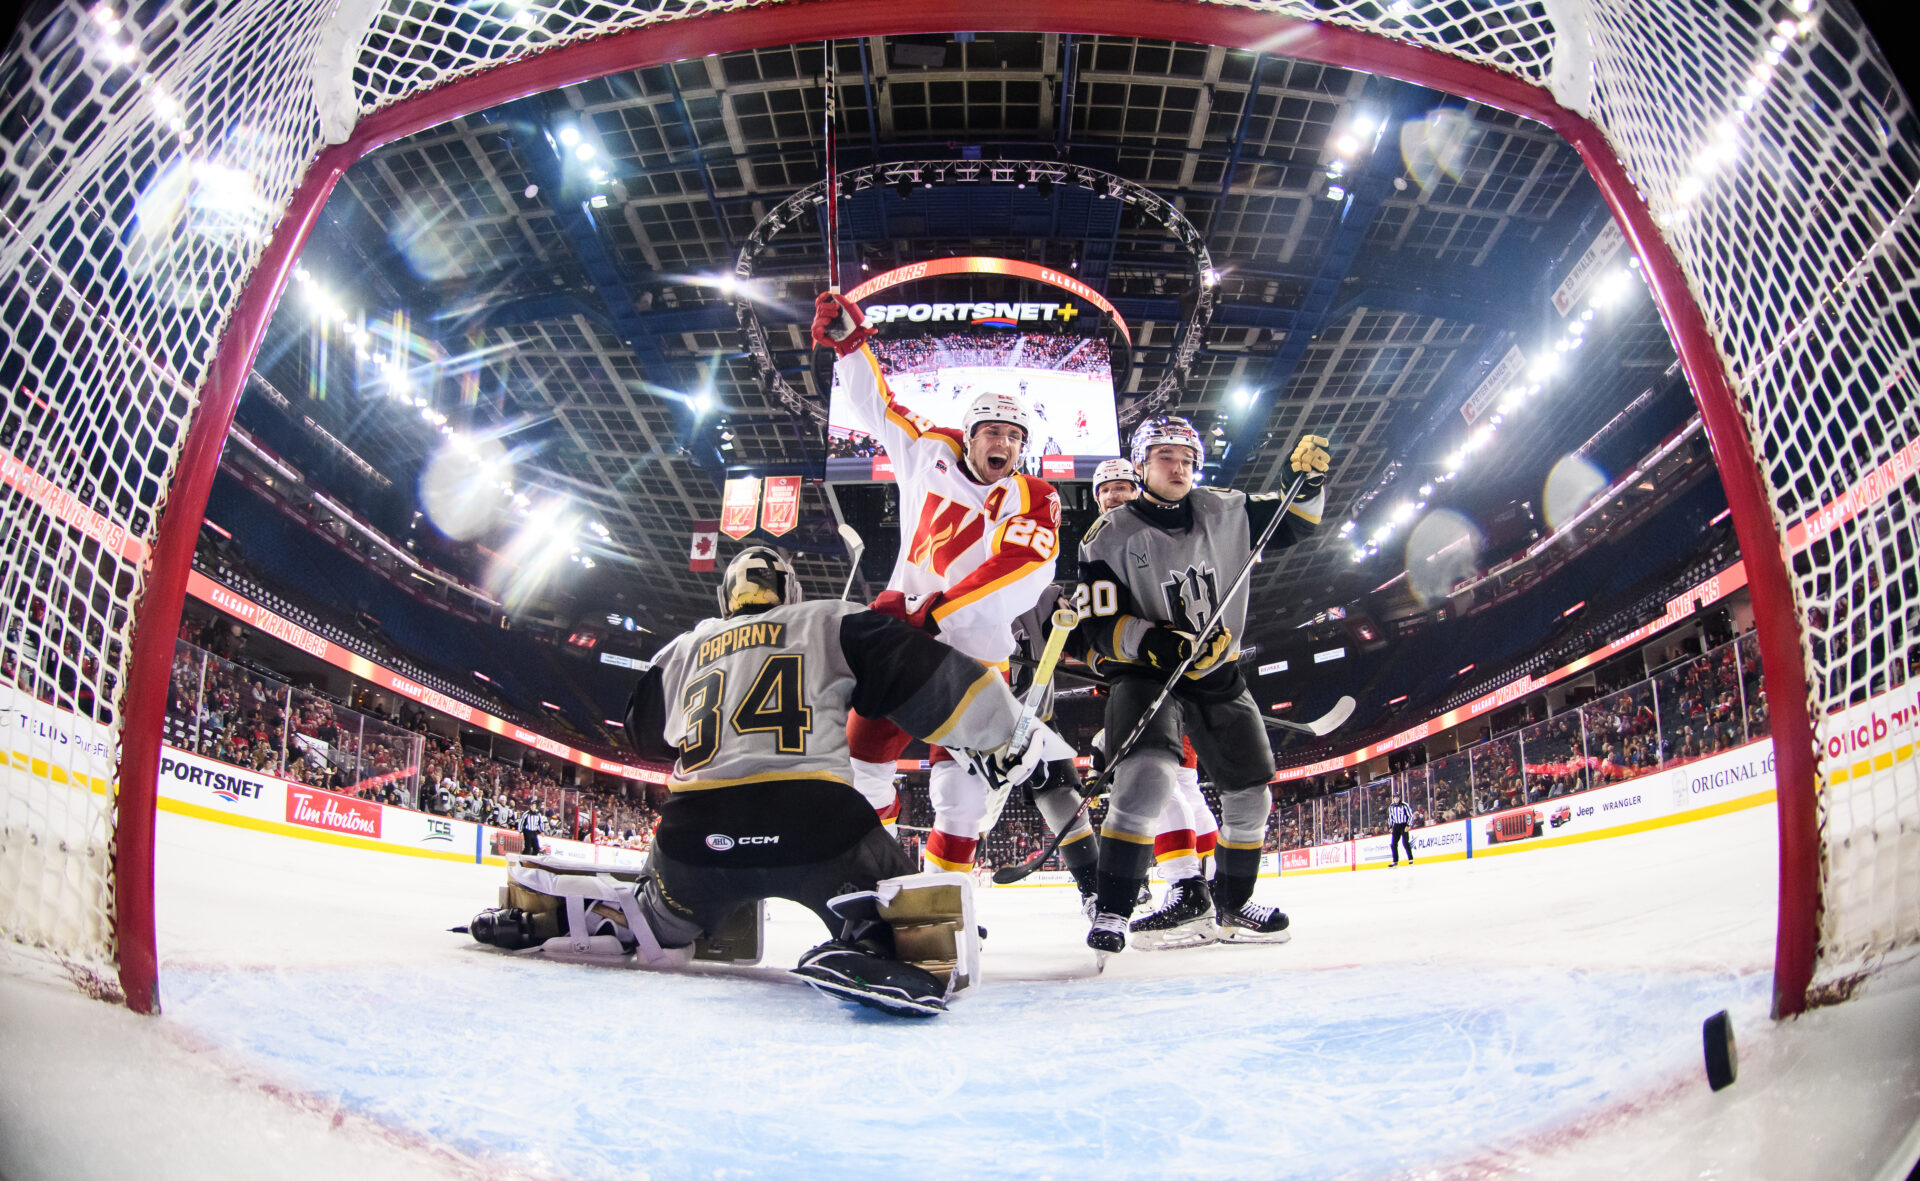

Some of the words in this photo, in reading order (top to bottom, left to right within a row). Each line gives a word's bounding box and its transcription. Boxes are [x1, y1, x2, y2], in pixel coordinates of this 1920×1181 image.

[1041, 270, 1090, 297] CALGARY
[984, 485, 1009, 522] A
[1003, 515, 1056, 560] 22
[1076, 579, 1118, 619] 20
[211, 588, 255, 618] CALGARY
[255, 605, 328, 658] WRANGLERS
[700, 623, 782, 666] PAPIRNY
[392, 677, 422, 699] CALGARY
[421, 687, 472, 721] WRANGLERS
[678, 653, 814, 775] 34
[1471, 695, 1496, 714] CALGARY
[160, 756, 264, 800] PORTSNET
[1279, 768, 1304, 780] CALGARY
[1691, 761, 1758, 794] ORIGINAL
[293, 792, 321, 820] Tim
[320, 801, 376, 834] Hortons
[1576, 805, 1595, 818] Jeep
[1602, 795, 1642, 812] WRANGLER
[427, 819, 452, 836] TCS
[738, 835, 780, 845] CCM
[1418, 833, 1463, 849] PLAYALBERTA
